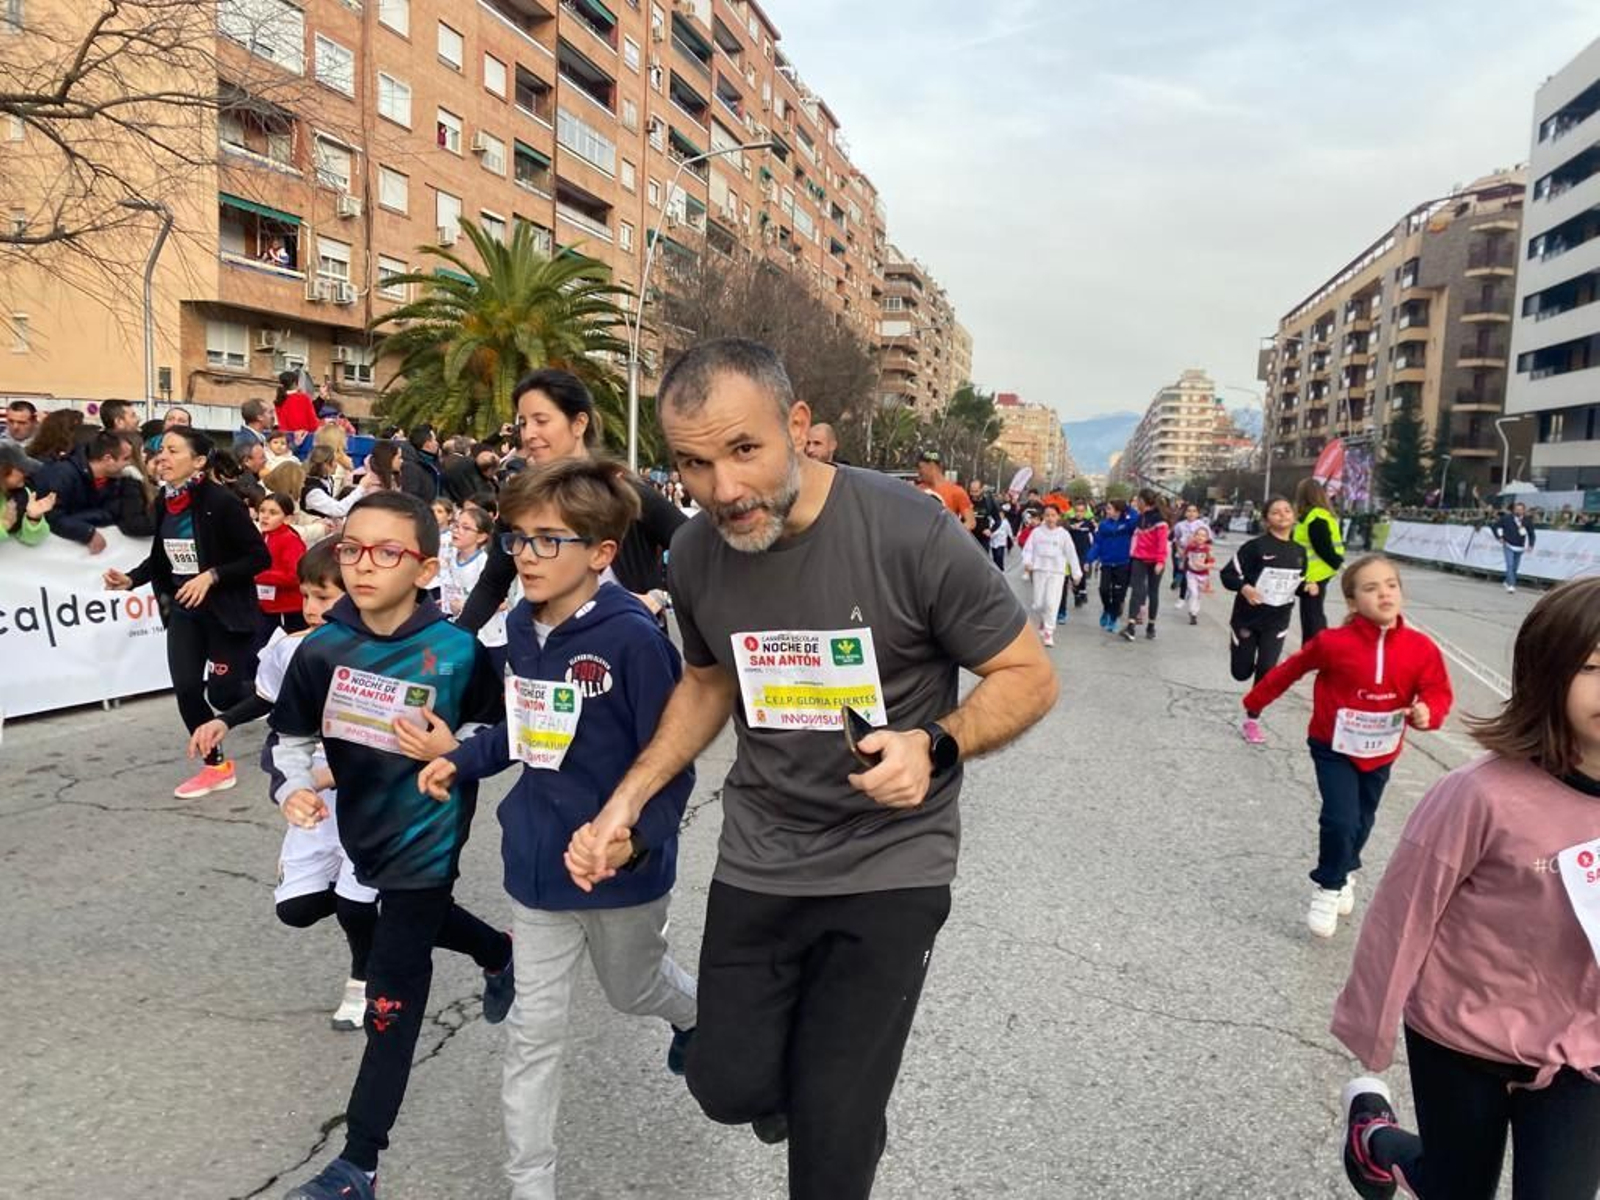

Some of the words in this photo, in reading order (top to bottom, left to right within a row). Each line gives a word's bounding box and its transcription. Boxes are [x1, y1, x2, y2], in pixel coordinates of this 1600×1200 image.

[763, 642, 802, 653] NOCHE
[804, 643, 819, 653] DE
[750, 655, 775, 666] SAN
[779, 653, 821, 667] ANTÓN
[336, 682, 358, 694] SAN
[351, 677, 383, 691] NOCHE
[384, 684, 397, 694] DE
[797, 696, 831, 705] GLORIA
[833, 694, 877, 705] FUERTES
[1364, 740, 1383, 749] 117
